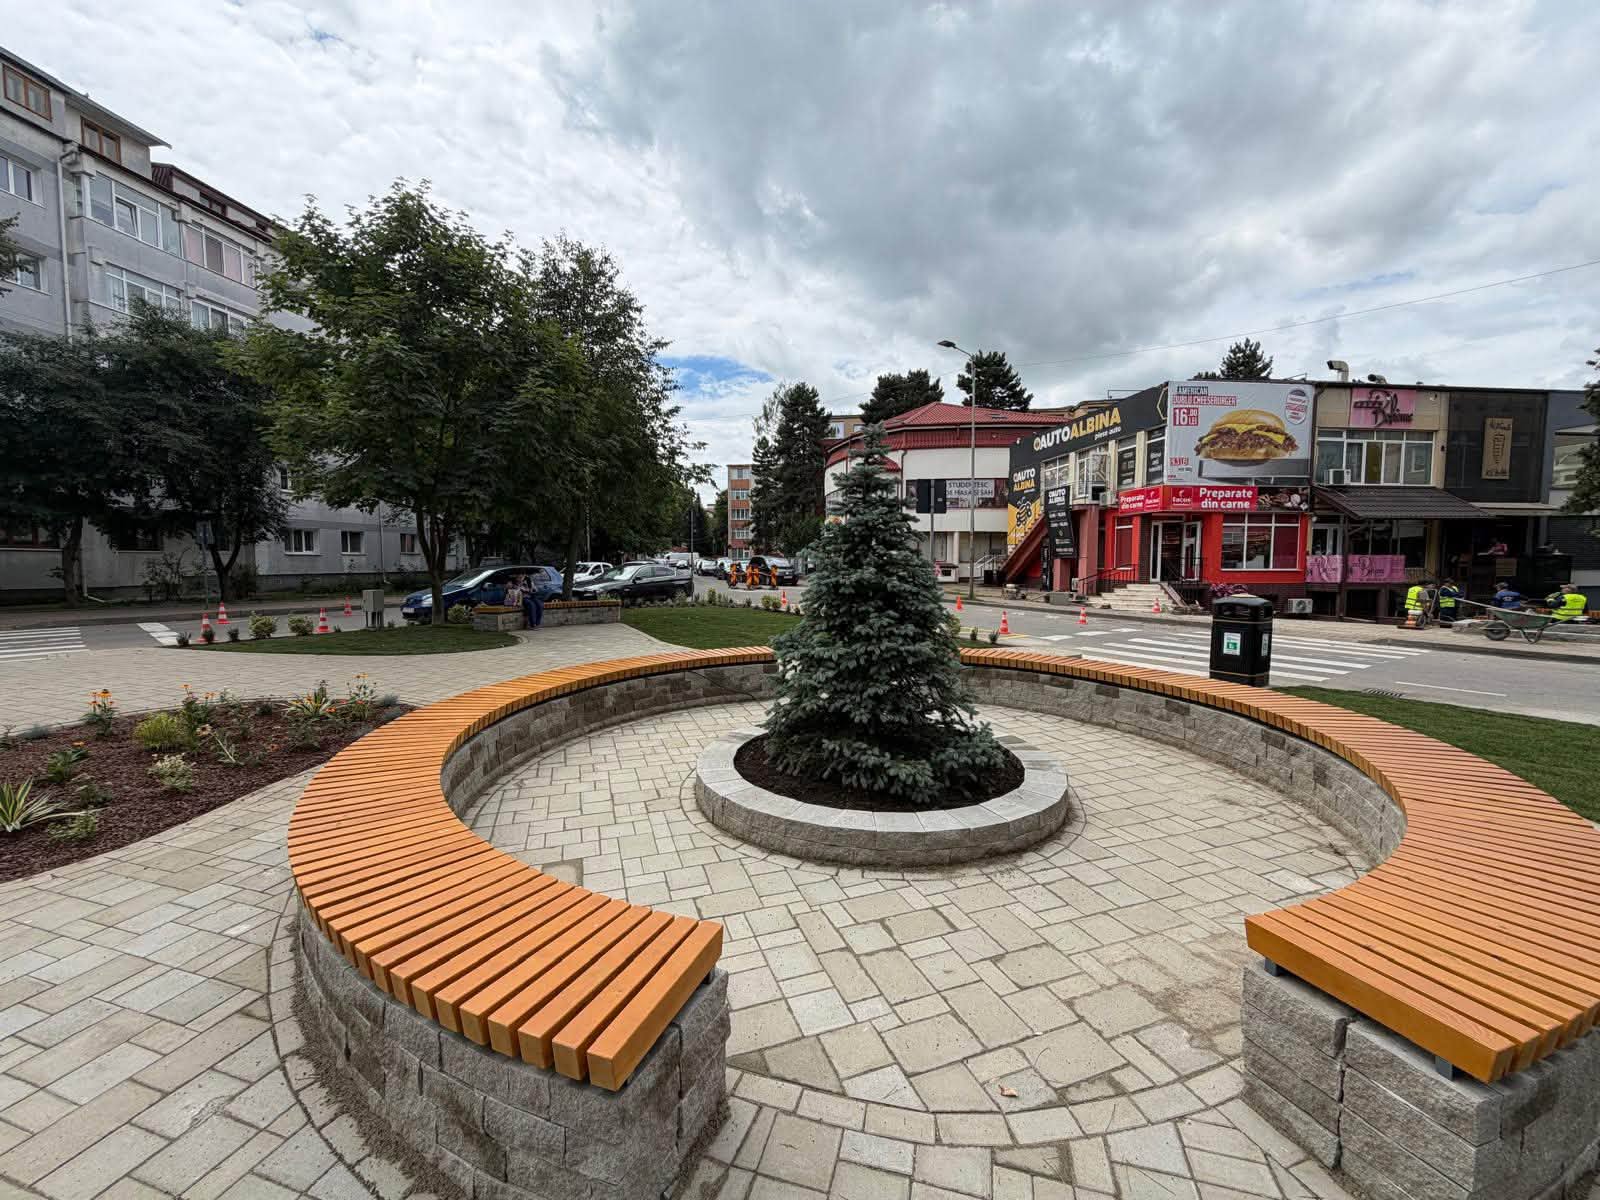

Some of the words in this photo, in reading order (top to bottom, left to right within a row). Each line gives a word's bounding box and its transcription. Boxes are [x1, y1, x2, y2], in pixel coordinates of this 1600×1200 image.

[1193, 396, 1236, 406] CHEESEBURGER
[1189, 416, 1198, 425] LEI
[1109, 426, 1122, 435] auto
[1013, 479, 1035, 491] ALBINA
[1120, 494, 1145, 504] Preparate
[1200, 488, 1253, 500] Preparate
[1129, 501, 1143, 509] carne
[1201, 498, 1218, 508] din
[1220, 500, 1250, 508] carne
